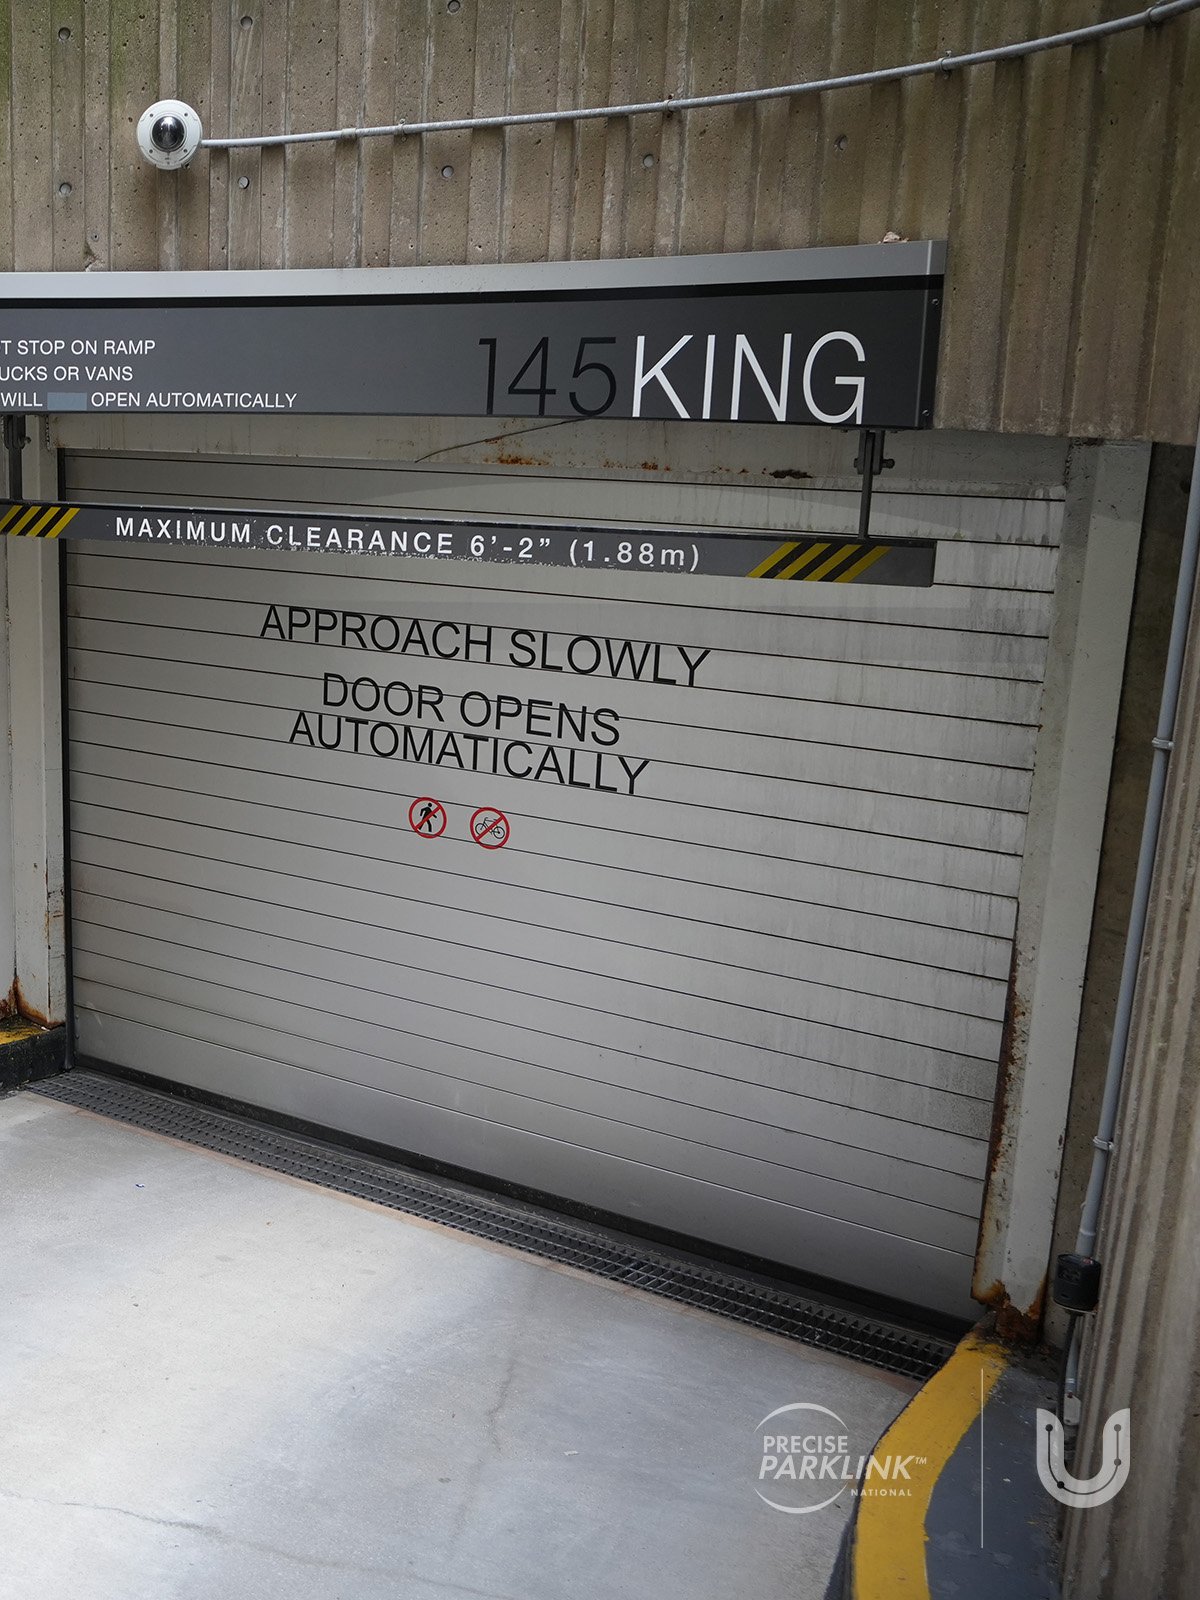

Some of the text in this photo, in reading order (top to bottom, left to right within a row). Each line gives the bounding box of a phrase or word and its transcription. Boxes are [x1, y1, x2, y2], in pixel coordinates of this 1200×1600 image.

[17, 340, 65, 355] STOP
[70, 340, 99, 355] ON
[104, 340, 156, 355] RAMP
[53, 366, 80, 381] OR
[85, 366, 133, 381] VANS
[0, 392, 43, 408] WILL
[90, 392, 141, 408] OPEN
[145, 392, 298, 408] AUTOMATICALLY
[115, 517, 251, 542] MAXIMUM
[266, 525, 453, 555] CLEARANCE
[568, 542, 701, 571] (1.88m)
[260, 605, 711, 687] APPROACH SLOWLY
[323, 673, 620, 746] DOOR OPENS
[289, 711, 650, 795] AUTOMATICALLY
